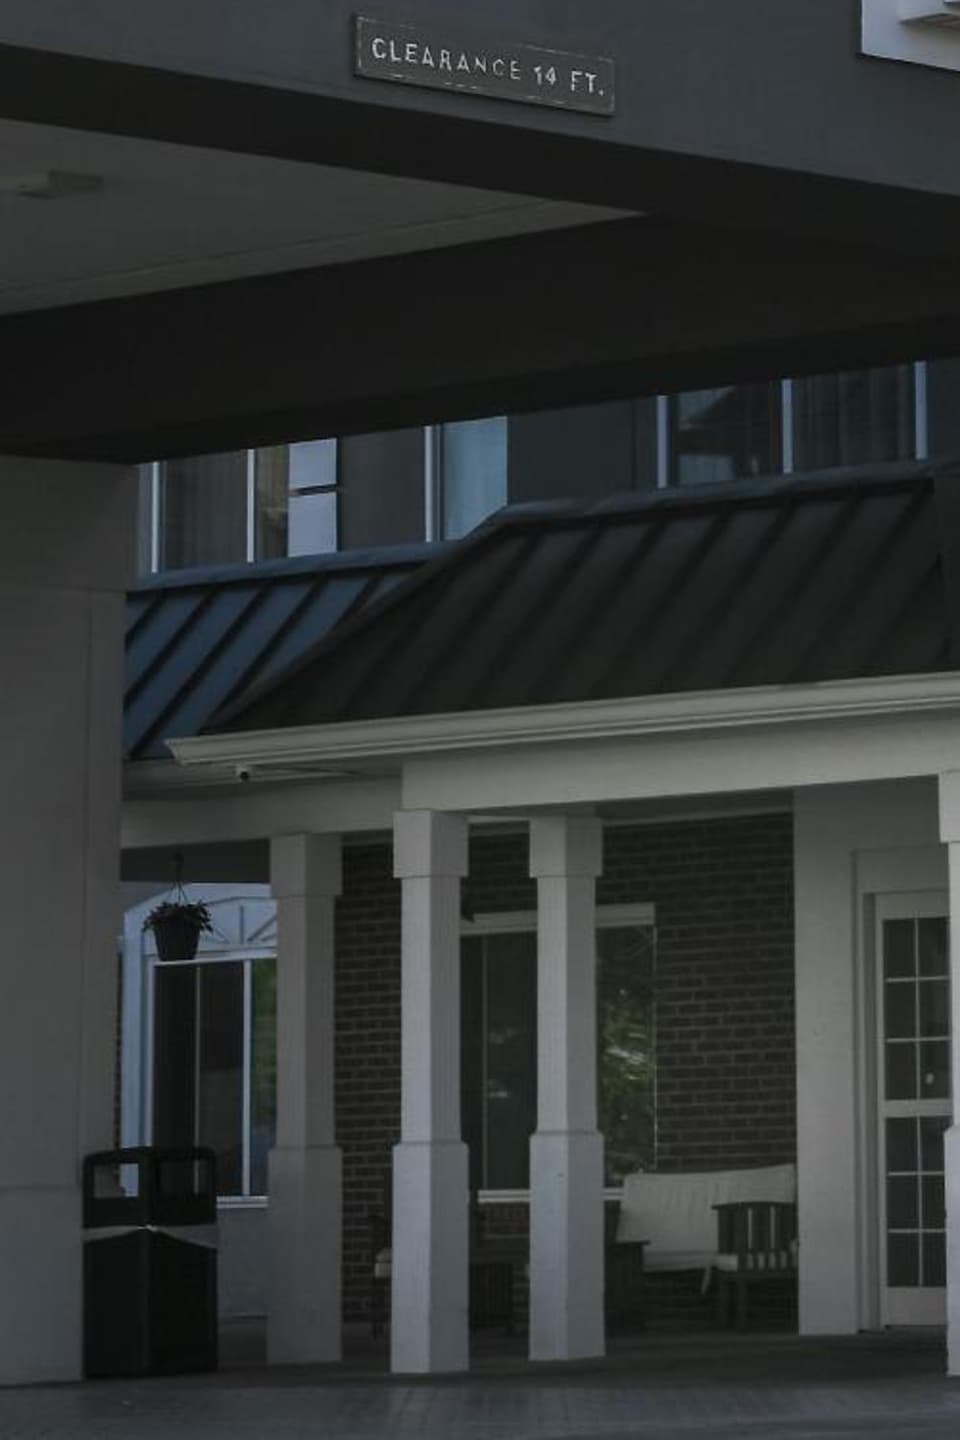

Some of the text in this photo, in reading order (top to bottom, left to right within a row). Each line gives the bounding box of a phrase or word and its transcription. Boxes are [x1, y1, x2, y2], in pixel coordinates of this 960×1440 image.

[371, 38, 605, 96] CLEARANCE 14 FT.
